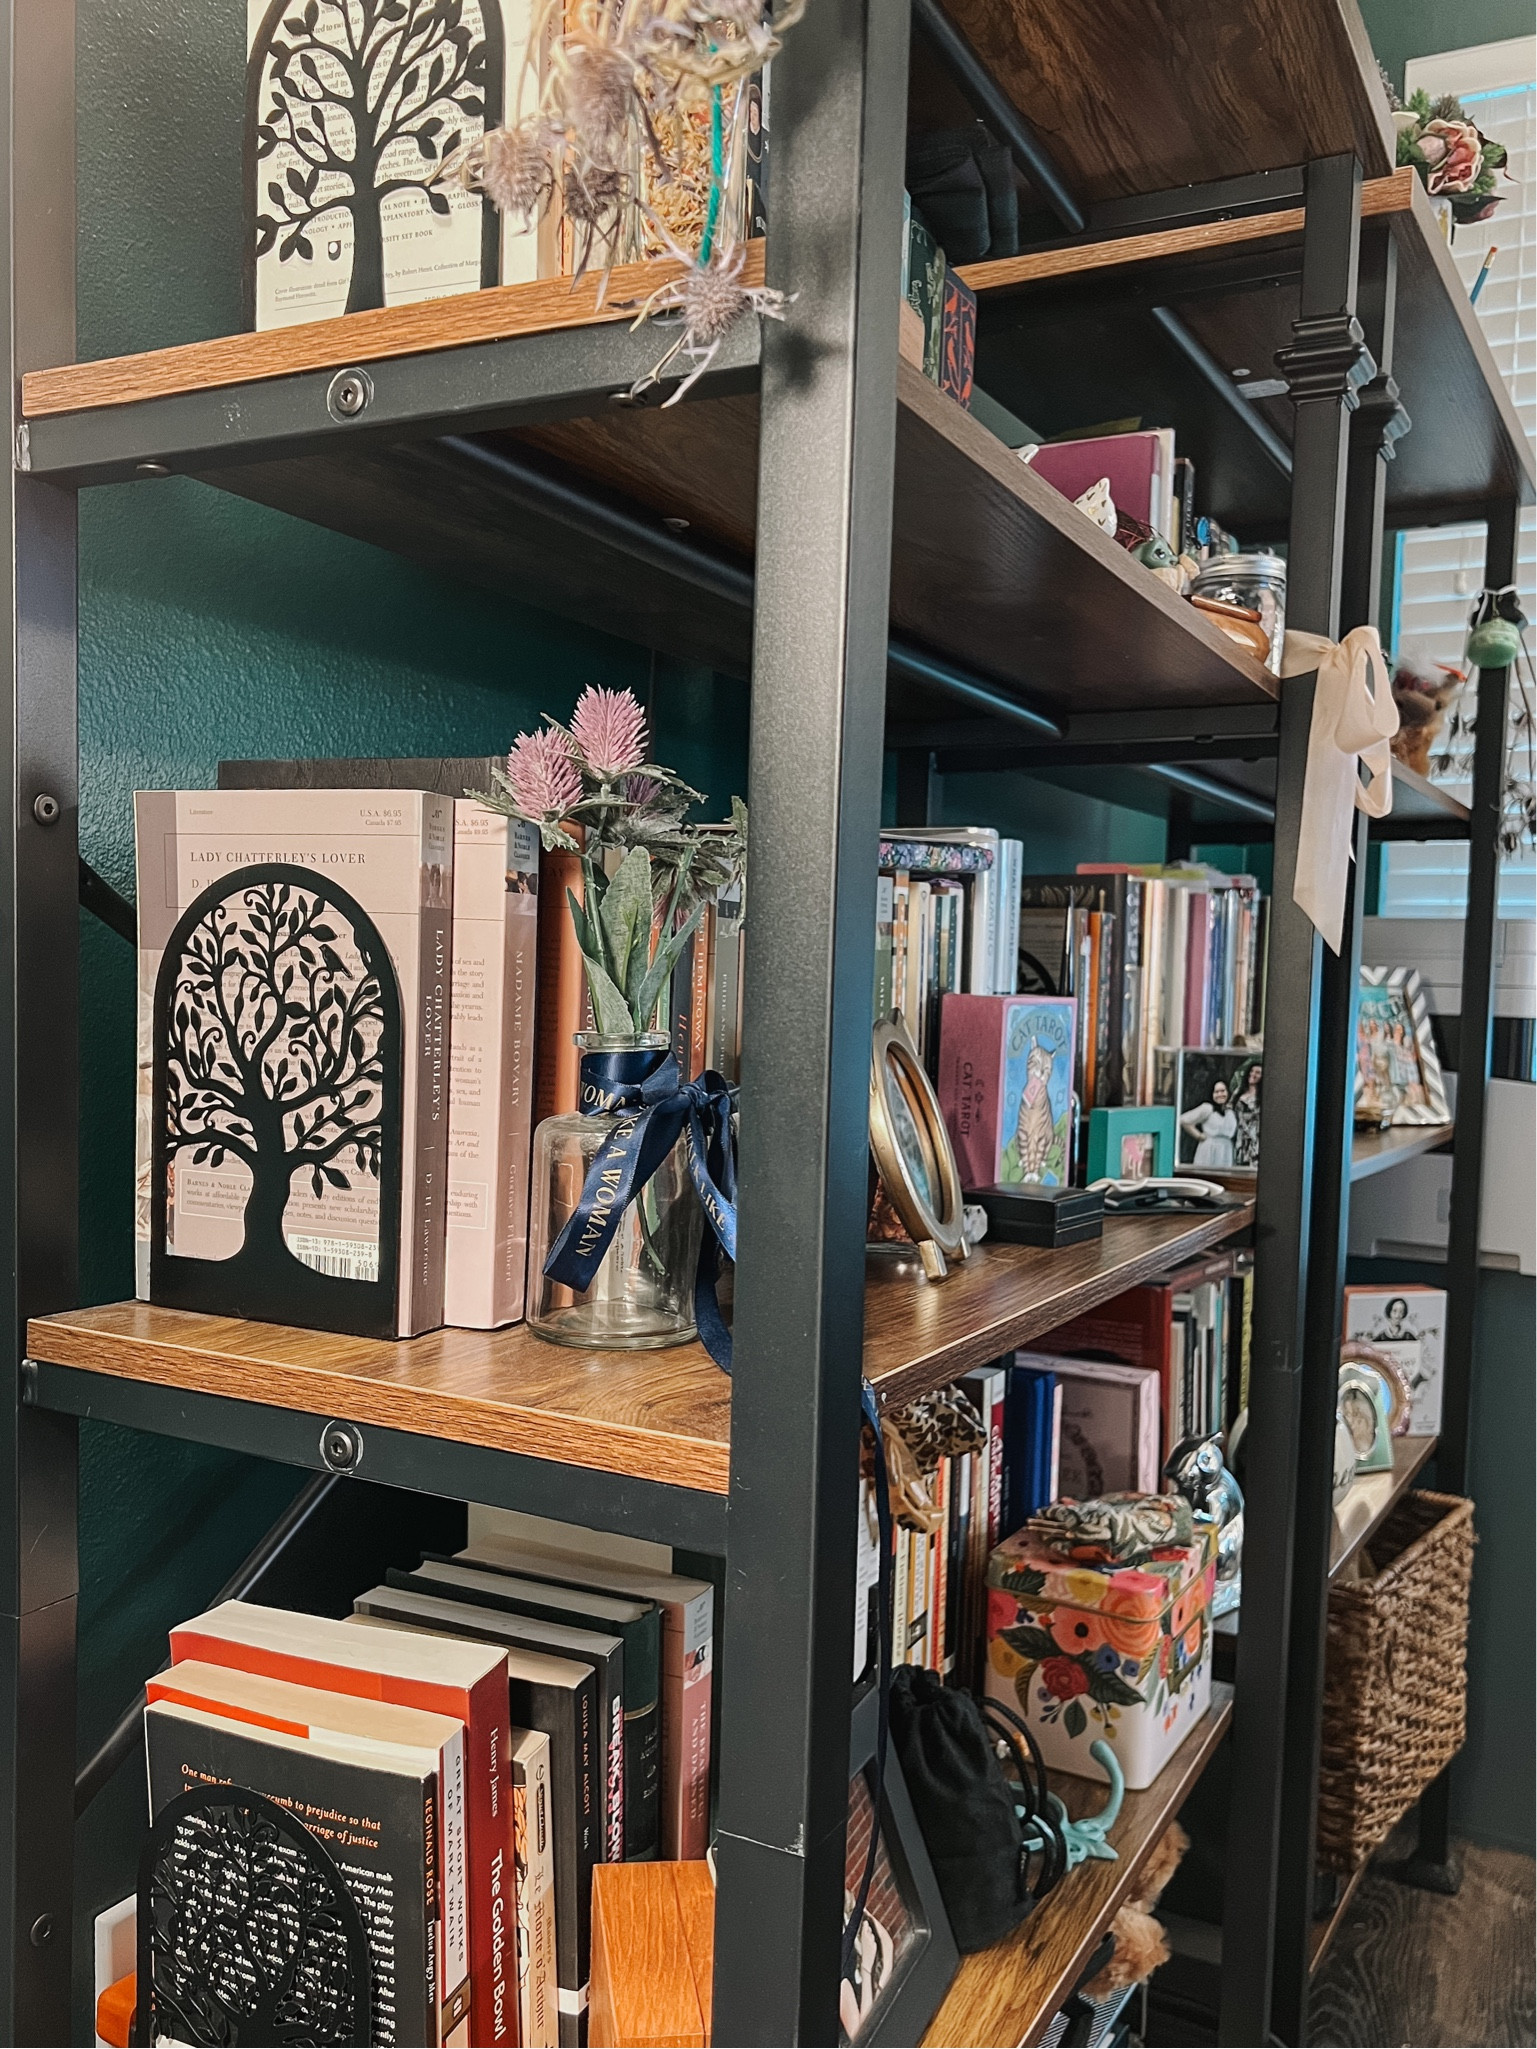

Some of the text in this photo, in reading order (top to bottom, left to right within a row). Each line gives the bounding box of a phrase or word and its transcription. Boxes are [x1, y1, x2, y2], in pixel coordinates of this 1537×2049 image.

[393, 167, 424, 180] spectrum
[393, 200, 411, 209] NOTE
[401, 231, 413, 240] SET
[415, 229, 433, 239] BOOK
[359, 808, 402, 819] U.S.A. $6.95
[470, 818, 489, 827] $6.95
[190, 851, 366, 864] LADY CHATTERLEY'S LOVER
[694, 952, 706, 1052] HEMINGWAY
[721, 973, 729, 1010] PRIDE
[424, 995, 433, 1058] LOVER
[432, 929, 444, 1121] LADY CHATTERLEY'S
[510, 949, 525, 1108] MADAME BOVARY
[1011, 1015, 1068, 1052] CAT TAROT
[962, 1061, 974, 1089] CAT
[960, 1094, 973, 1139] TAROT
[606, 1145, 628, 1161] A
[212, 1191, 240, 1201] affordable
[302, 1202, 327, 1213] presents
[332, 1194, 356, 1203] editions
[575, 1167, 624, 1258] WOMAN
[699, 1183, 726, 1232] LIKE
[422, 1172, 434, 1287] D. H. Lawrence
[504, 1163, 517, 1283] Gustave Flaubert
[582, 1694, 590, 1740] LOUISA
[610, 1695, 622, 1788] BREAK,
[488, 1727, 501, 1818] Henry James
[689, 1717, 699, 1821] AND DAMNED
[697, 1700, 707, 1823] THE BEAUTIFUL
[181, 1762, 198, 1778] One
[199, 1770, 218, 1784] man
[295, 1798, 304, 1811] to
[306, 1802, 348, 1824] prejudice
[349, 1813, 360, 1824] so
[361, 1816, 382, 1832] that
[336, 1829, 380, 1849] of justice
[424, 1797, 435, 1907] REGINALD ROSE
[582, 1825, 591, 1852] Work
[340, 1861, 375, 1879] American
[446, 1788, 456, 1949] OF MARK TWAIN
[455, 1755, 465, 1963] GREAT SHORT WORKS
[353, 1879, 395, 1898] Angry Men
[362, 1894, 395, 1914] The play
[372, 1928, 396, 1941] rather
[373, 1914, 395, 1928] guilty
[533, 1902, 546, 1954] Morte
[424, 1919, 436, 2004] Twelve Angry Men
[490, 1847, 507, 2042] The Golden Bowl
[379, 1959, 395, 1971] and
[377, 1985, 396, 1999] After
